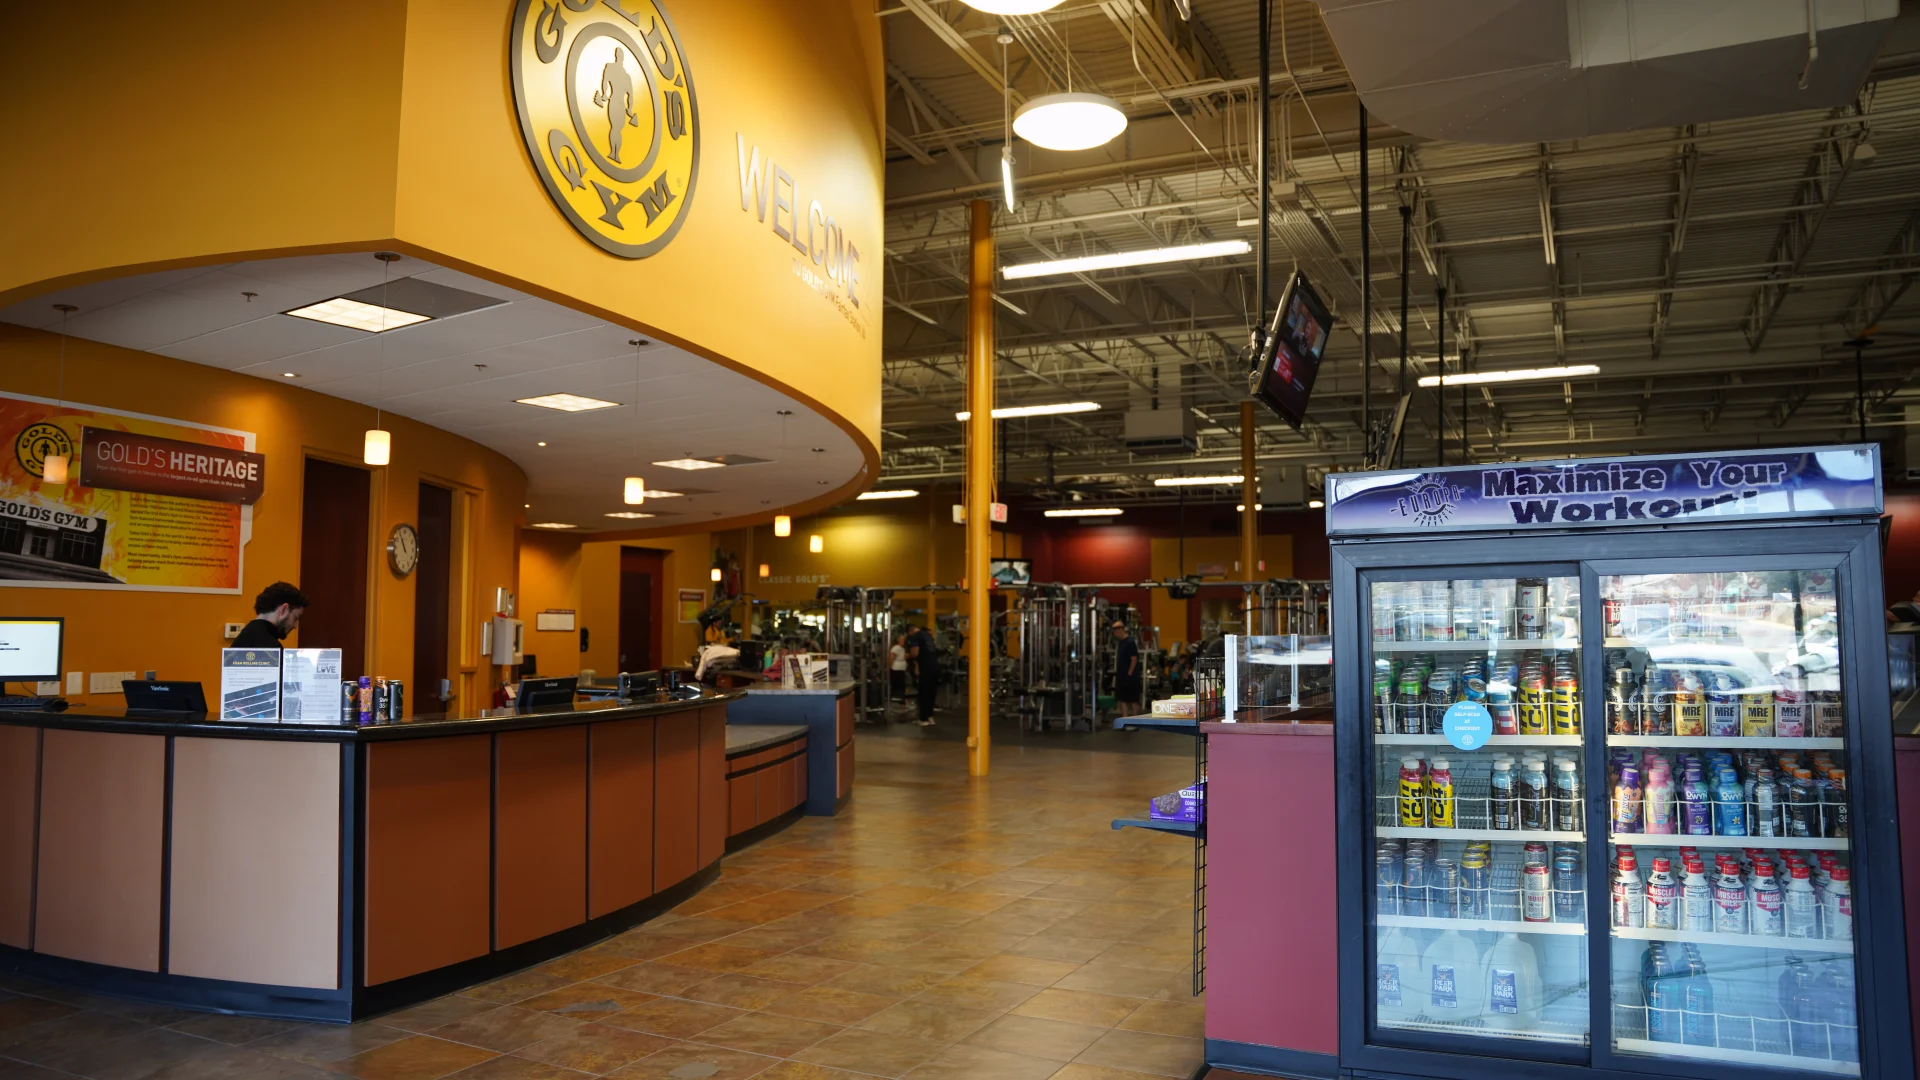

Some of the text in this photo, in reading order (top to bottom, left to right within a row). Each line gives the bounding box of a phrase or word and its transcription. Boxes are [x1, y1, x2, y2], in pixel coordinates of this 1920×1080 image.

[548, 129, 678, 230] GYM
[736, 131, 859, 309] WELCOME
[97, 441, 258, 481] GOLD'S HERITAGE
[170, 472, 184, 481] largest
[198, 476, 208, 484] gym
[1484, 462, 1786, 496] Maximize Your
[1398, 485, 1460, 517] EUROPA
[0, 501, 51, 522] GOLD'S
[53, 512, 88, 530] GYM
[1153, 703, 1176, 714] ONE
[1528, 691, 1544, 728] C4
[1682, 707, 1701, 716] MRE
[1715, 706, 1734, 717] MRE
[1748, 707, 1768, 717] MRE
[1781, 706, 1801, 717] MRE
[1411, 787, 1423, 818] C4
[1433, 787, 1445, 818] C4
[1648, 887, 1672, 897] MUSCLE
[1717, 891, 1742, 900] MUSCLE
[1434, 985, 1453, 993] PARK
